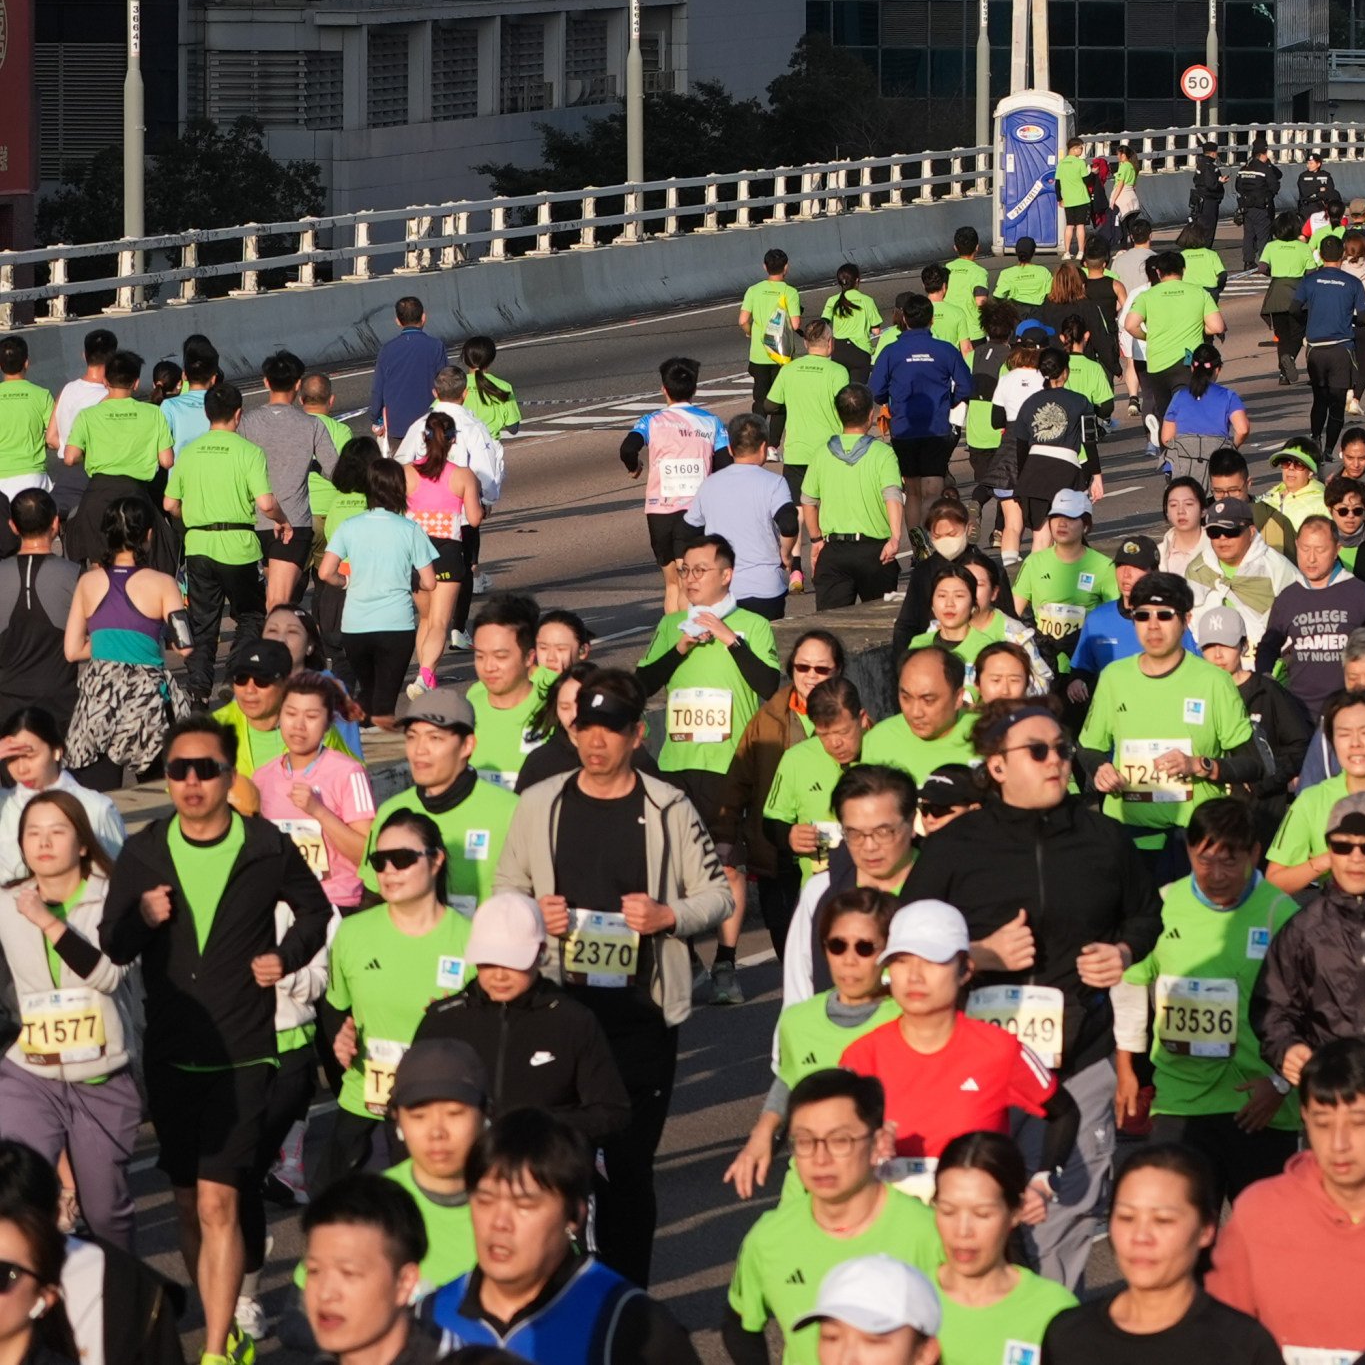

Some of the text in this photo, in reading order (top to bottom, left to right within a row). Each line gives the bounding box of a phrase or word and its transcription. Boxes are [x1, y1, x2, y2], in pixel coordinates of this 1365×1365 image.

[1188, 76, 1209, 89] 50
[665, 464, 700, 475] S1609
[1292, 609, 1349, 627] COLLEGE
[1316, 623, 1339, 634] DAY
[673, 708, 728, 727] T0863
[1162, 1006, 1233, 1035] T3536
[23, 1015, 99, 1046] T1577
